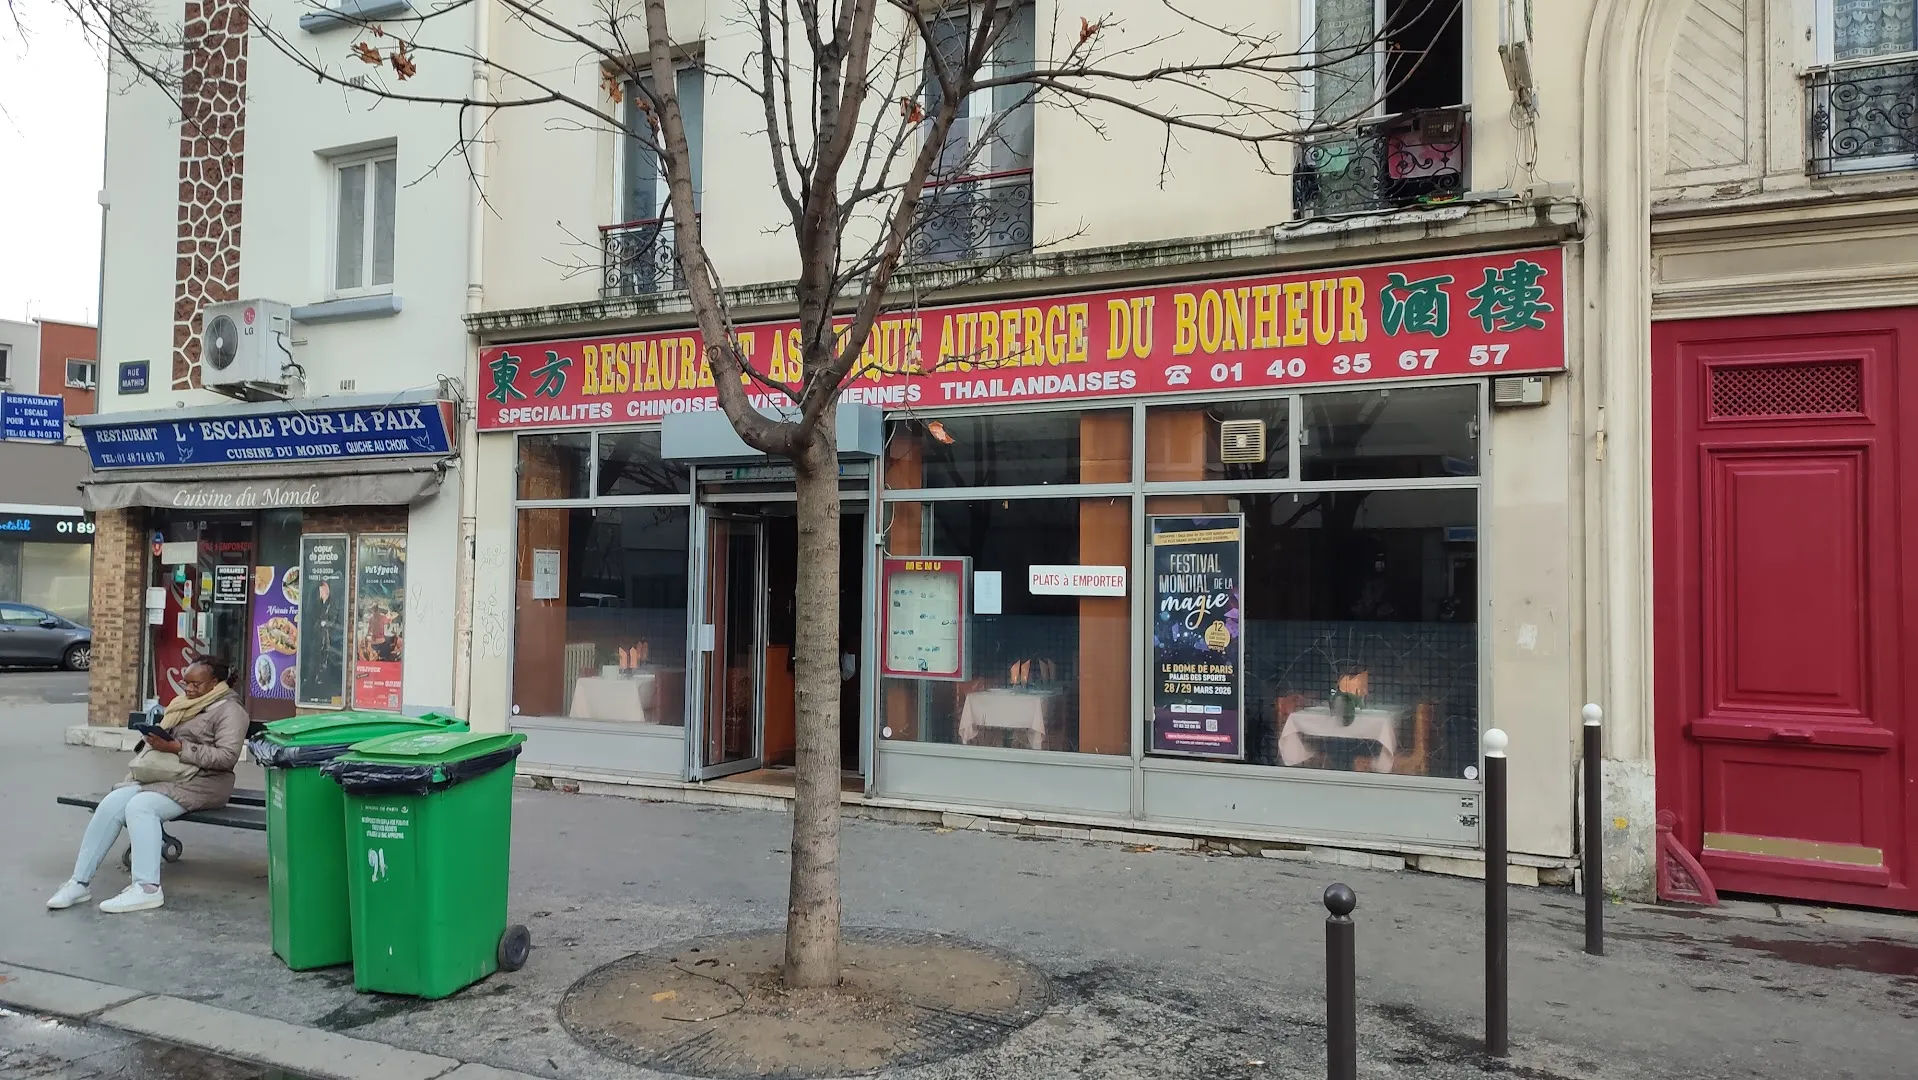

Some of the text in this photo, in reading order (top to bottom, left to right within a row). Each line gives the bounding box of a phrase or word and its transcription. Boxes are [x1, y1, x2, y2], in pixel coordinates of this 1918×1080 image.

[1380, 259, 1554, 338] 酒樓
[244, 327, 254, 336] LG
[582, 332, 755, 396] RESTAURAT
[936, 303, 1089, 372] AUBERGE
[1106, 295, 1156, 360] DU
[1173, 276, 1368, 356] BONHEUR
[127, 368, 140, 376] RUE
[486, 350, 574, 405] 東方
[122, 378, 145, 387] MATHIS
[498, 344, 1510, 424] SPECIALITES CHINOISE VIETIENNES THAILANDAISES 01 40 35 67 57
[6, 396, 59, 407] RESTAURANT
[6, 417, 60, 428] POUR LA PAIX
[96, 427, 158, 443] RESTAURANT
[277, 413, 337, 438] POUR
[338, 412, 369, 433] LA
[371, 408, 426, 432] PAIX
[27, 430, 36, 438] 48
[36, 430, 44, 438] 74
[53, 431, 61, 439] 70
[226, 438, 409, 459] CUISINE DU MONDE QUICHE AU CHOIX
[128, 453, 136, 463] 48
[137, 452, 145, 463] 74
[147, 452, 155, 462] 03
[156, 452, 165, 462] 70
[173, 484, 320, 507] Cuisine du Monde
[56, 521, 73, 533] 01
[905, 561, 941, 571] MENU
[1170, 553, 1221, 573] FESTIVAL
[1033, 574, 1124, 587] PLATS à EMPORTER
[1159, 574, 1233, 593] MONDIAL DE LA
[1161, 593, 1229, 630] magie
[1214, 622, 1223, 632] 12
[1162, 663, 1234, 675] LE DOME DE PARIS
[1203, 674, 1226, 682] SPORTS
[1164, 683, 1175, 693] 28
[1181, 683, 1192, 693] 29
[1193, 685, 1213, 694] MARS
[1214, 686, 1232, 695] 2026
